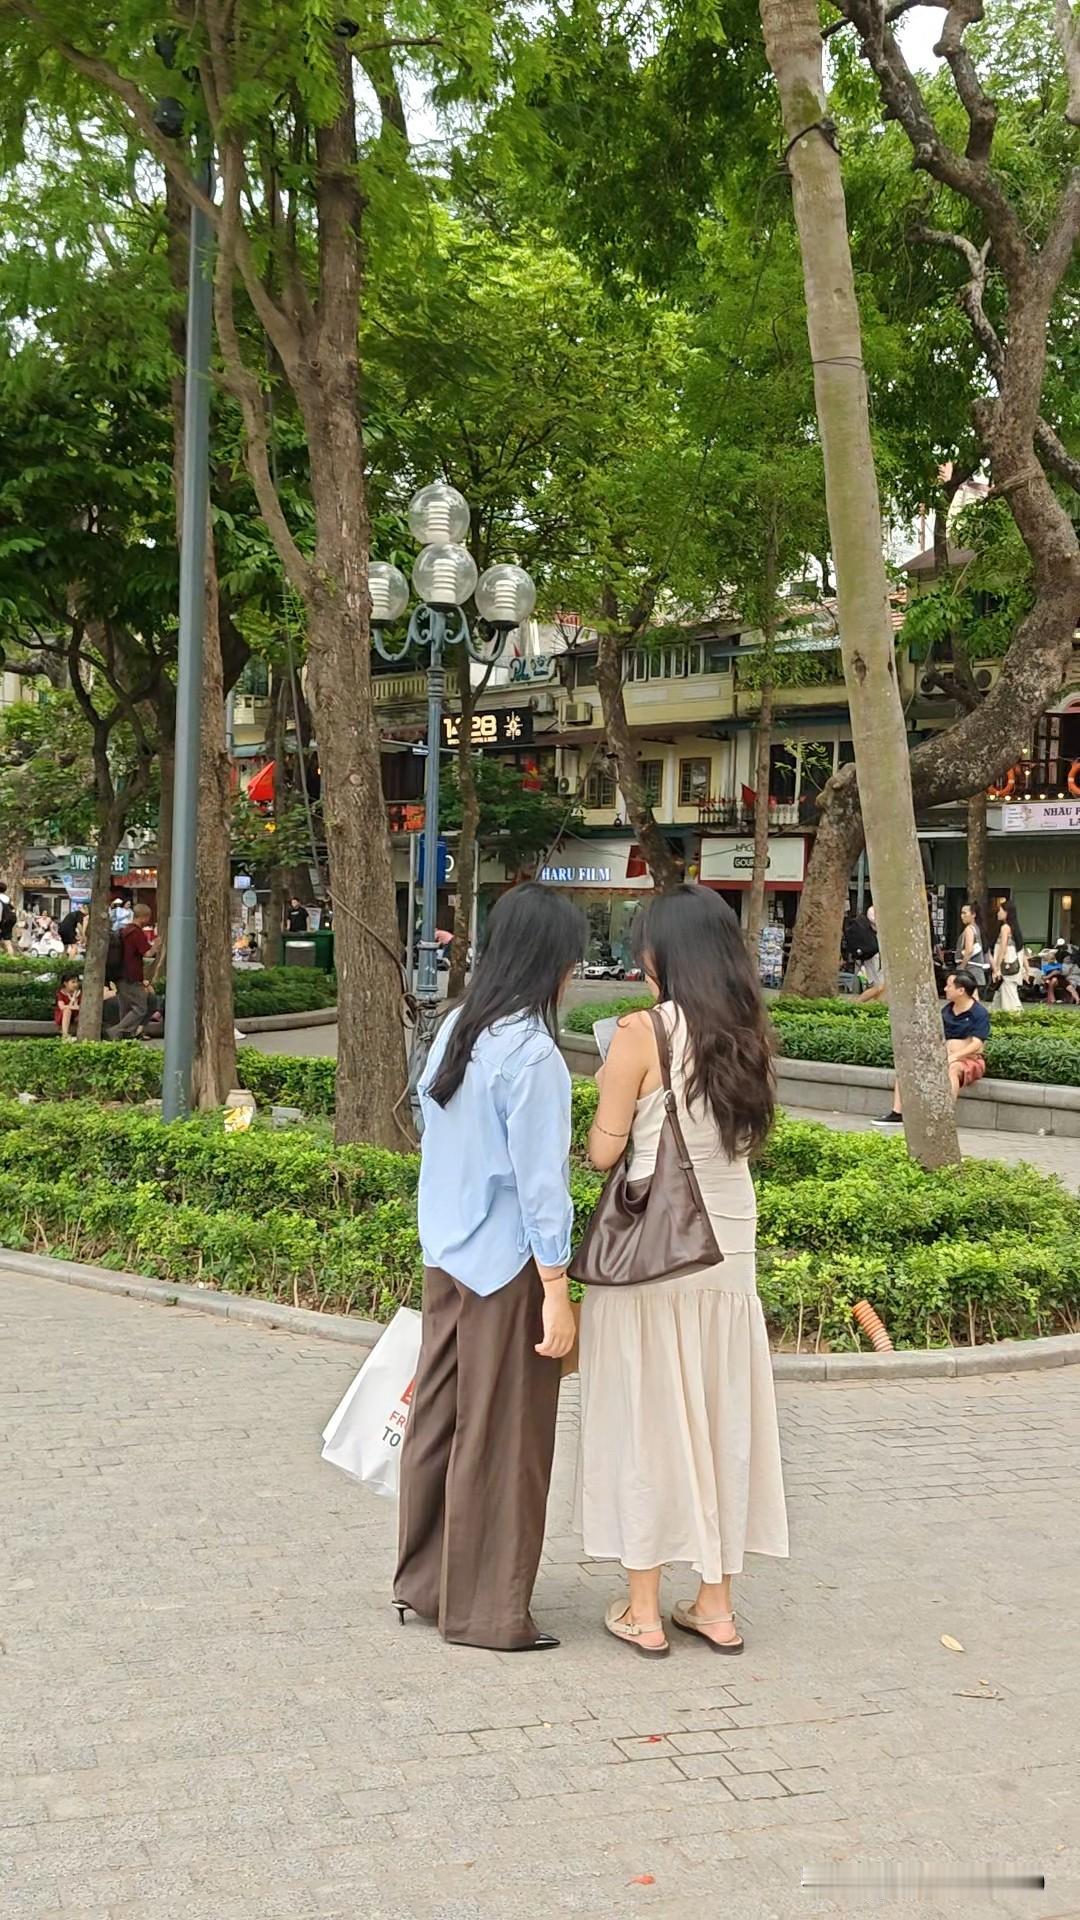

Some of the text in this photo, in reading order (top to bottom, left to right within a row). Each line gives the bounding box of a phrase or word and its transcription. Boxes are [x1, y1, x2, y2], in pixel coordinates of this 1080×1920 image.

[541, 867, 610, 881] HARU FILM
[389, 1410, 407, 1428] FR
[382, 1426, 402, 1447] TO
